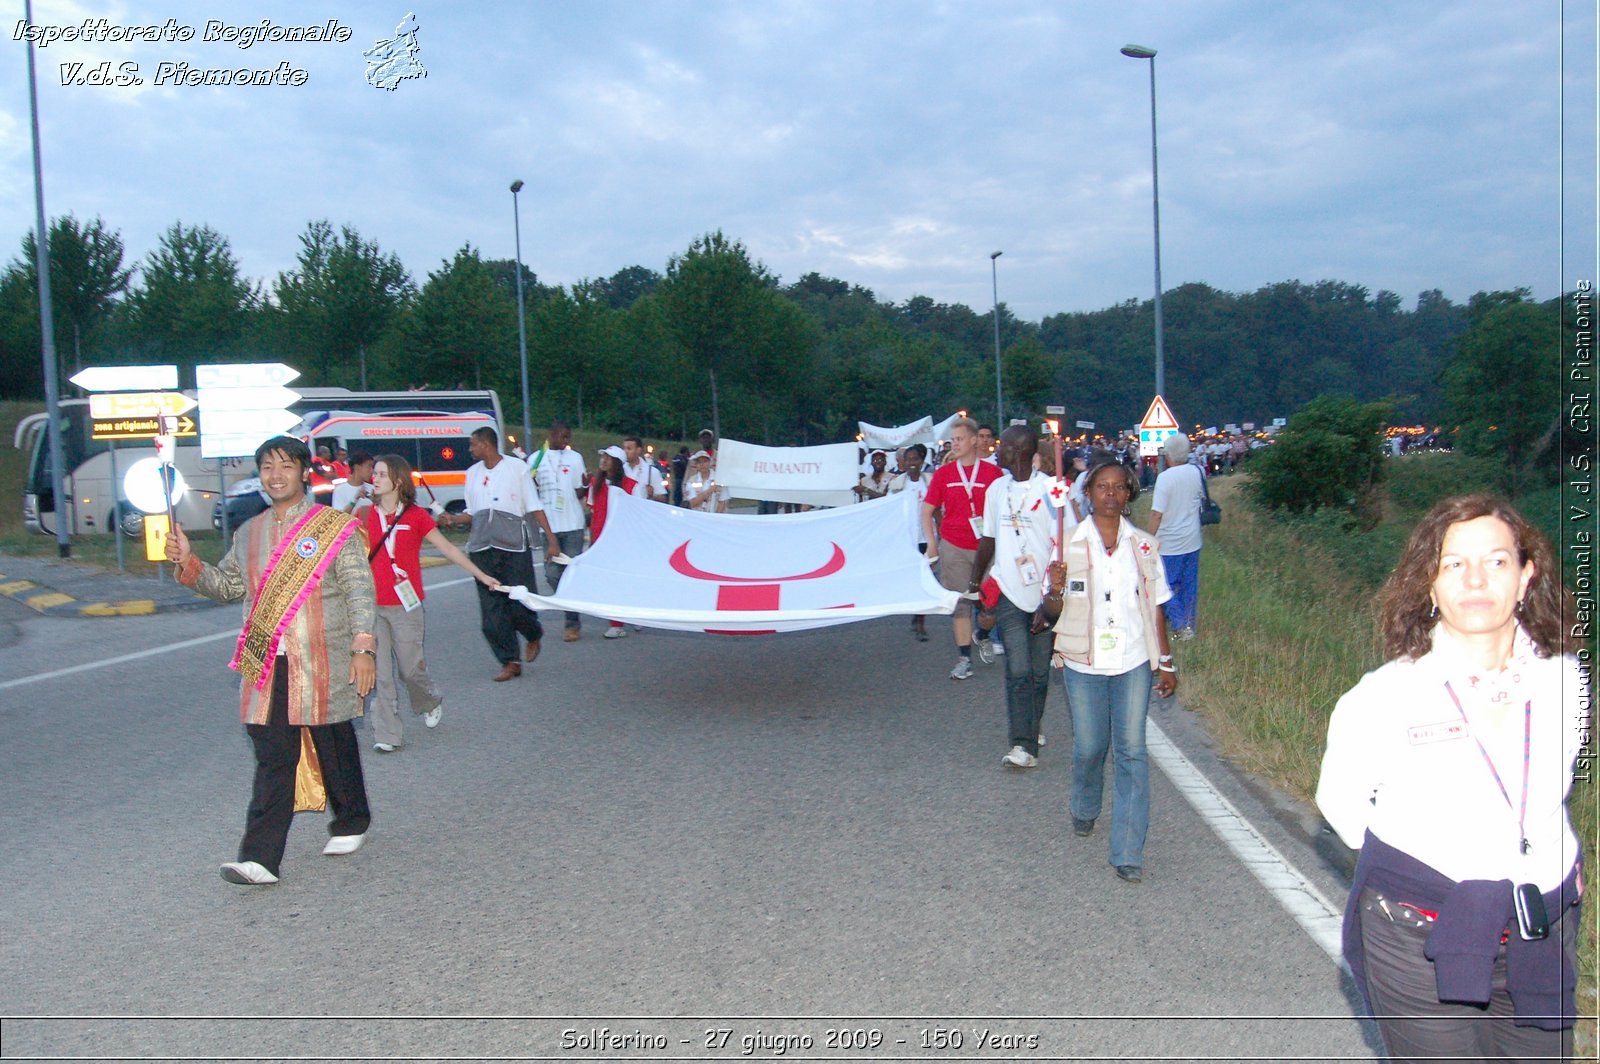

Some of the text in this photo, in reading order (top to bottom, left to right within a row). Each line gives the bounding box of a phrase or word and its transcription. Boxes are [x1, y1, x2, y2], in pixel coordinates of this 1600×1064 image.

[93, 419, 159, 433] zona artigianale
[361, 426, 465, 437] CROCE ROSSA ITALIANA
[753, 460, 823, 475] HUMANITY
